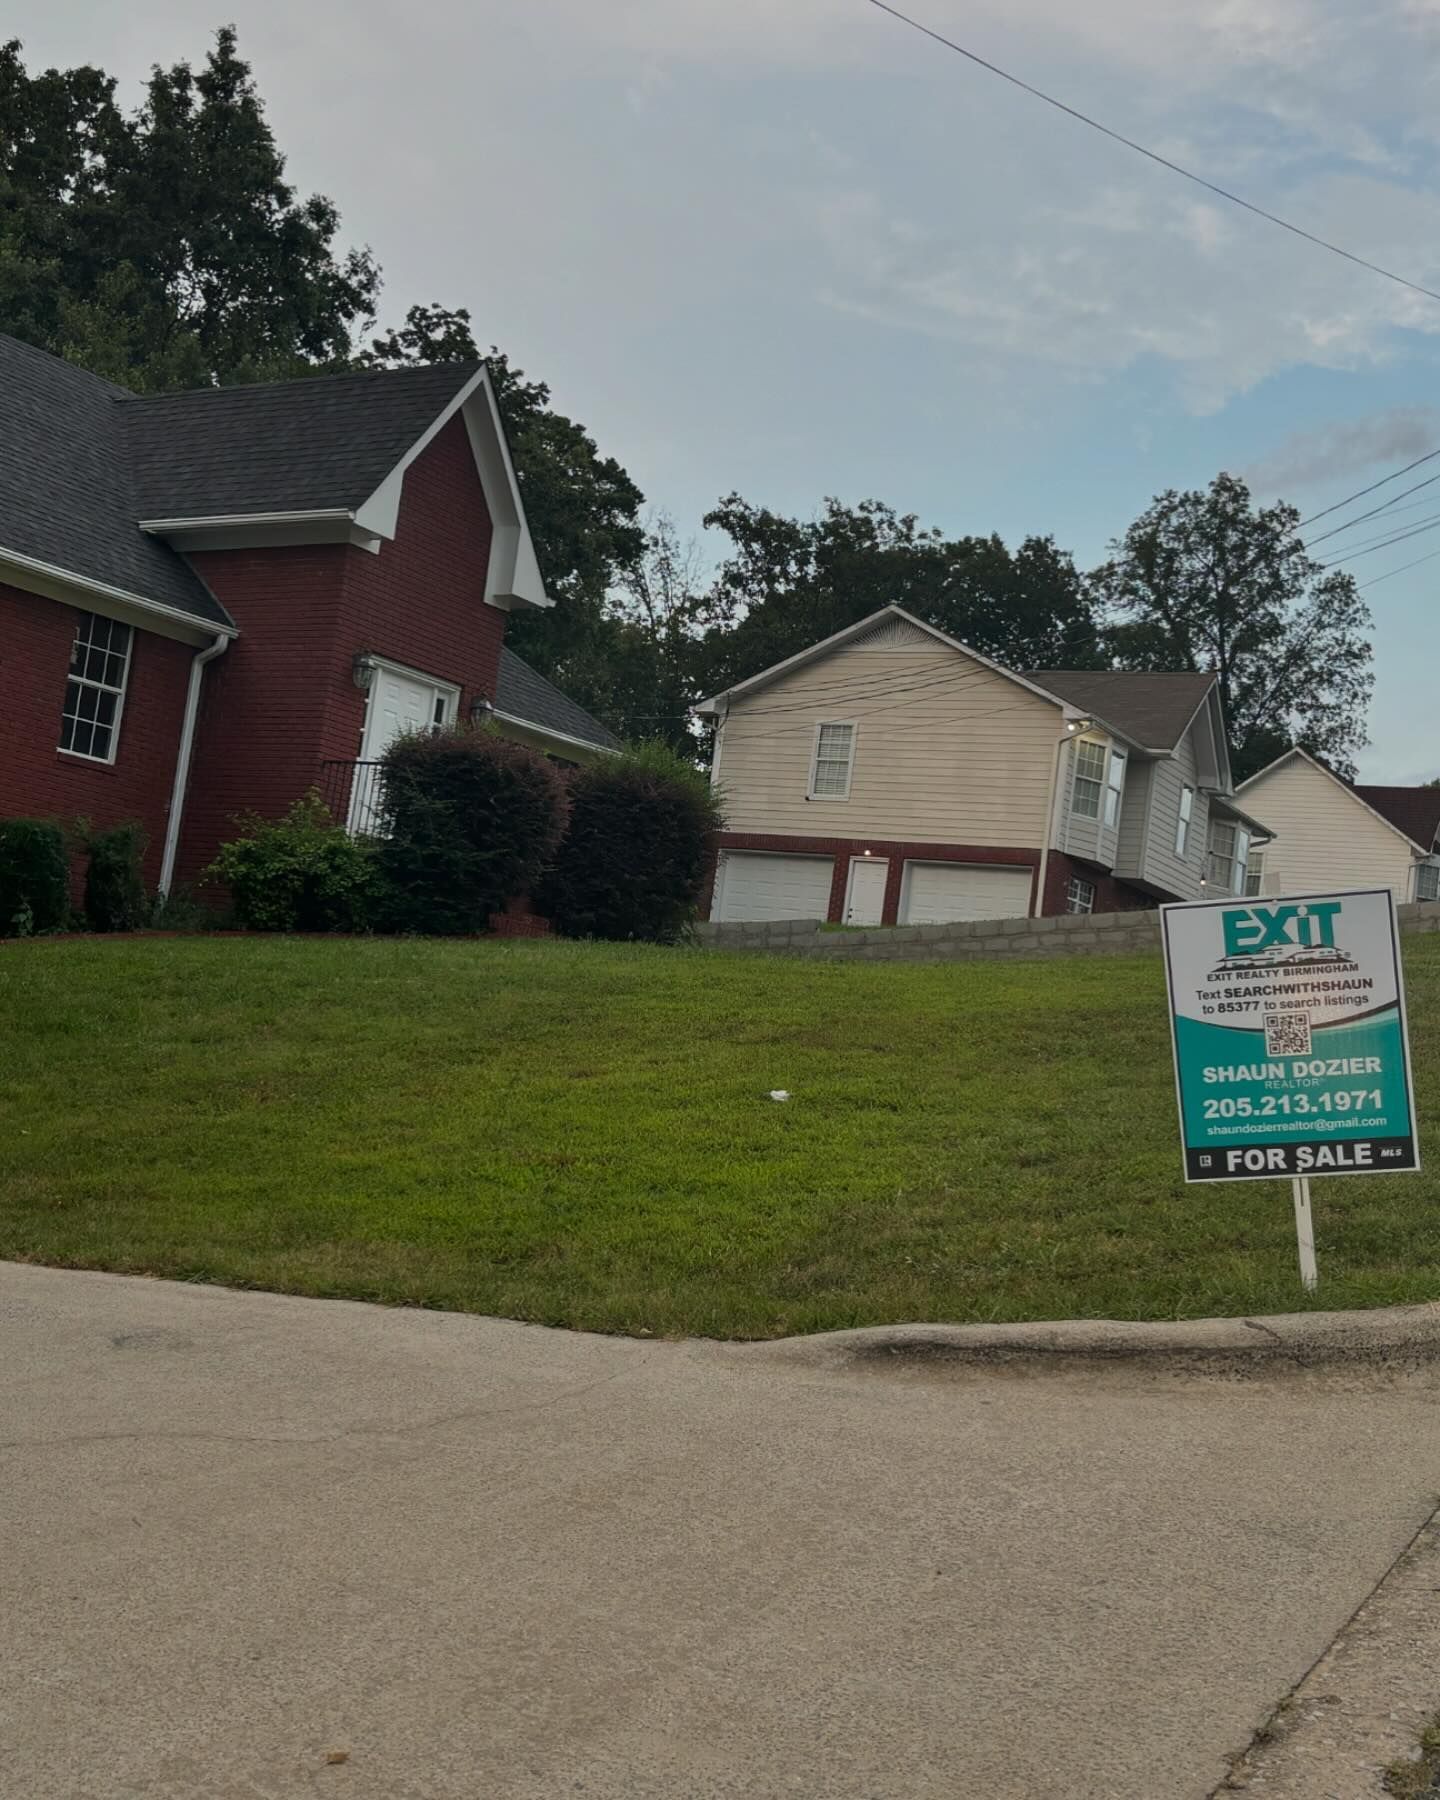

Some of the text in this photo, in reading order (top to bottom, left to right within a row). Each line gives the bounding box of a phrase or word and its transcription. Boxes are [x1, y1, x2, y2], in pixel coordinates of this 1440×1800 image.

[1207, 963, 1360, 982] EXIT REALTY BIRMINGHAM
[1196, 978, 1374, 1000] Text SEARCHWITHSHAUN
[1202, 993, 1369, 1014] to 85377 to search listings
[1203, 1057, 1382, 1083] SHAUN DOZIER
[1203, 1089, 1383, 1119] 205.213.1971
[1207, 1117, 1387, 1135] shaundozierrealtor@gmail.com
[1226, 1148, 1288, 1172] FOR
[1296, 1143, 1374, 1169] SALE
